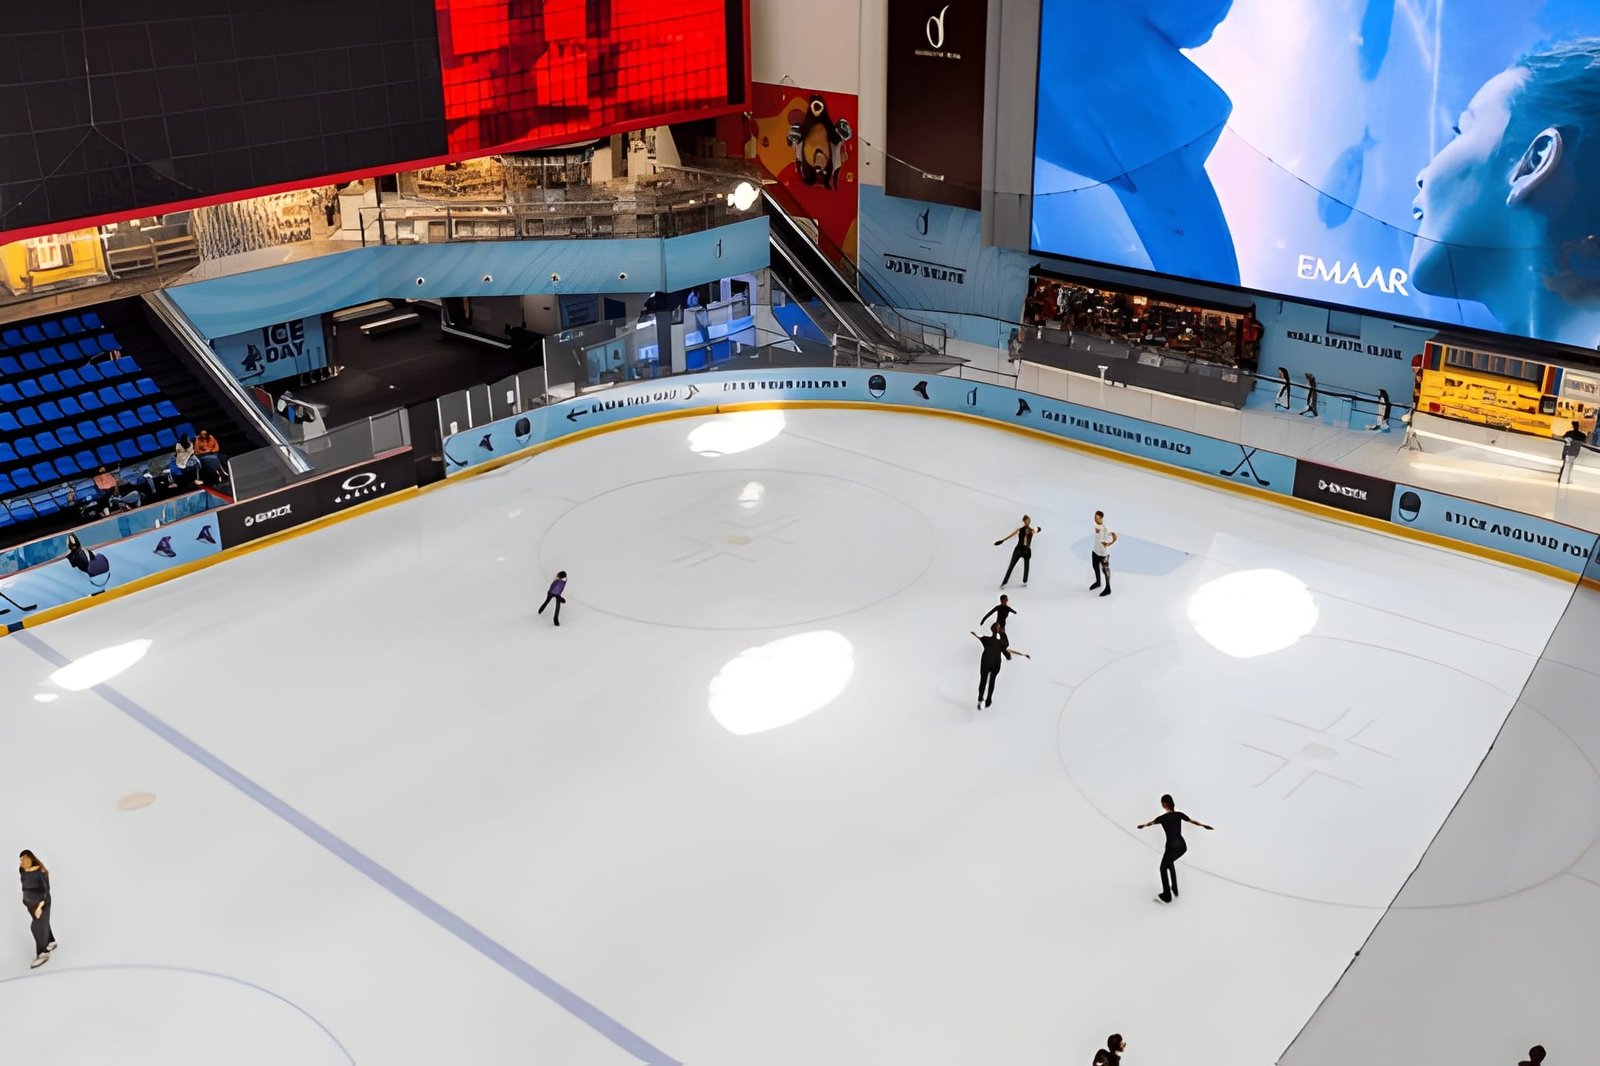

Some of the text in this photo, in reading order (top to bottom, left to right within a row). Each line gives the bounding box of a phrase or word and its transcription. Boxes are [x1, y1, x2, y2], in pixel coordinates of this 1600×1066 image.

[1297, 254, 1409, 297] EMAAR
[262, 318, 304, 348] ICE
[265, 341, 304, 363] DAY
